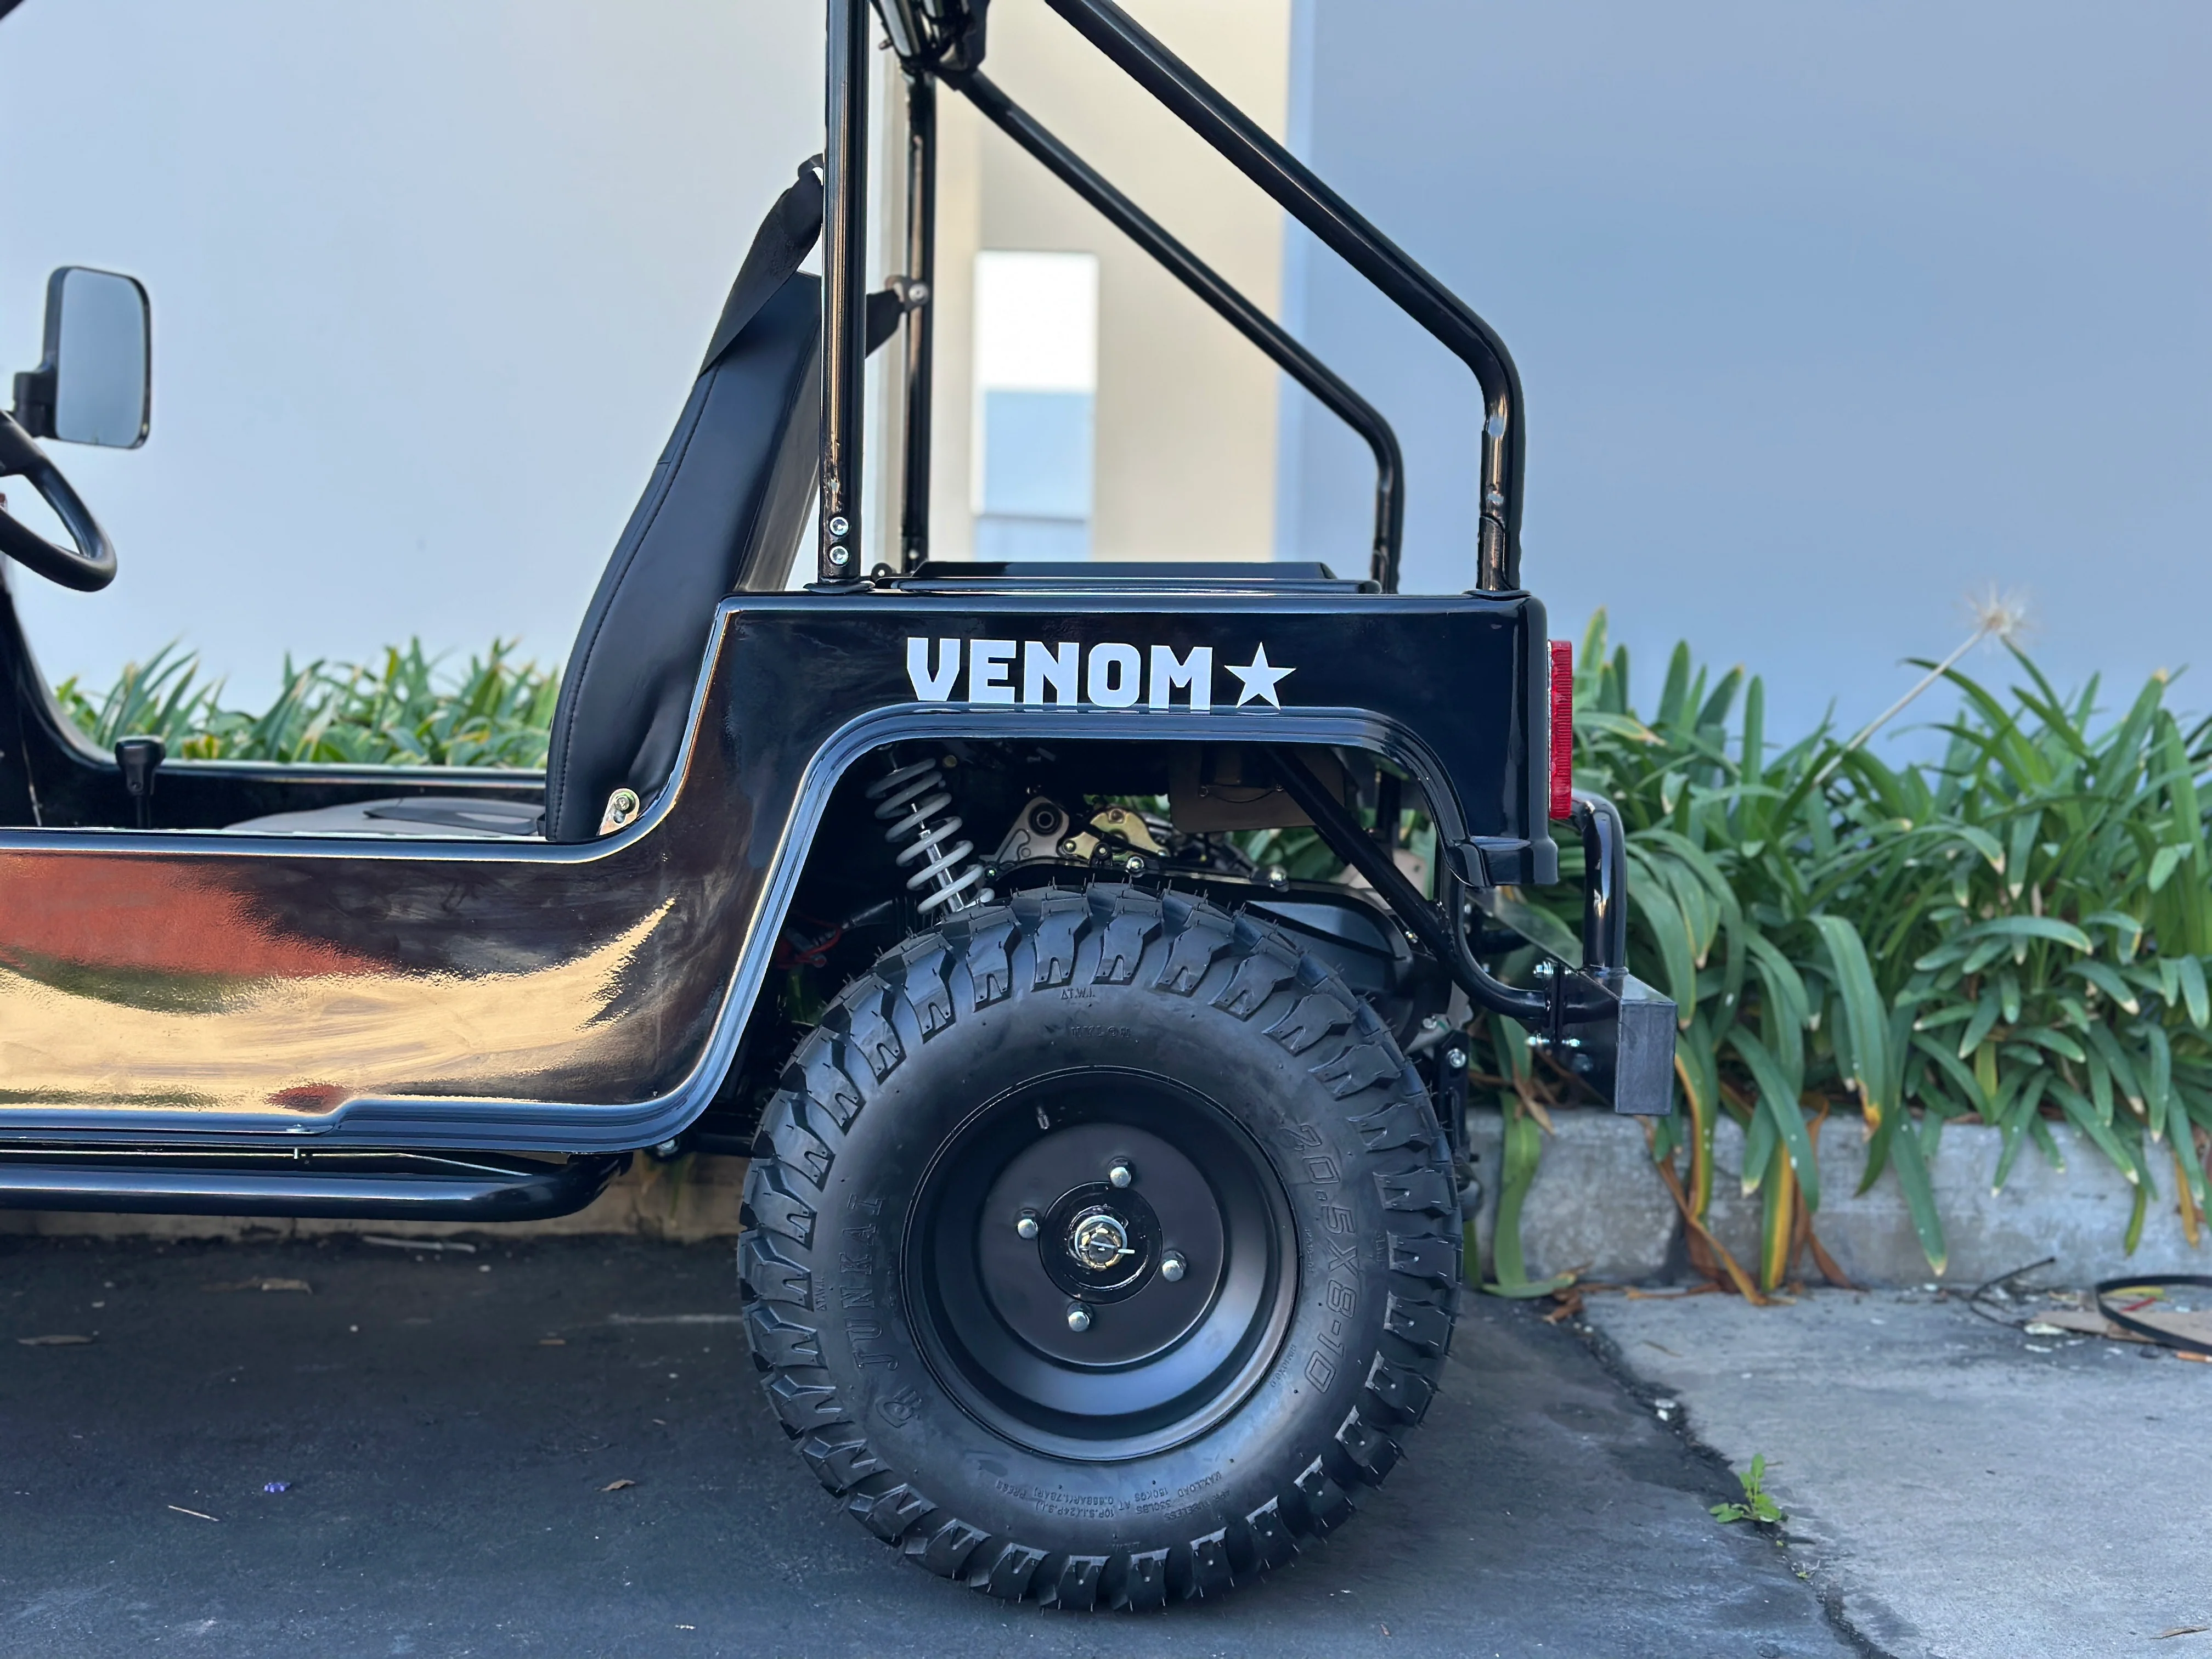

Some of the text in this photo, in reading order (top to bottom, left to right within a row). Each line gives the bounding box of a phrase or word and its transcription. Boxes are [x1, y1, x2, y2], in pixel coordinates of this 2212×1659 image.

[907, 637, 1212, 710] VENOM
[1071, 1025, 1131, 1039] NYLON
[839, 1193, 899, 1372] JUNKAI
[1278, 1123, 1360, 1394] 20.5X8-10
